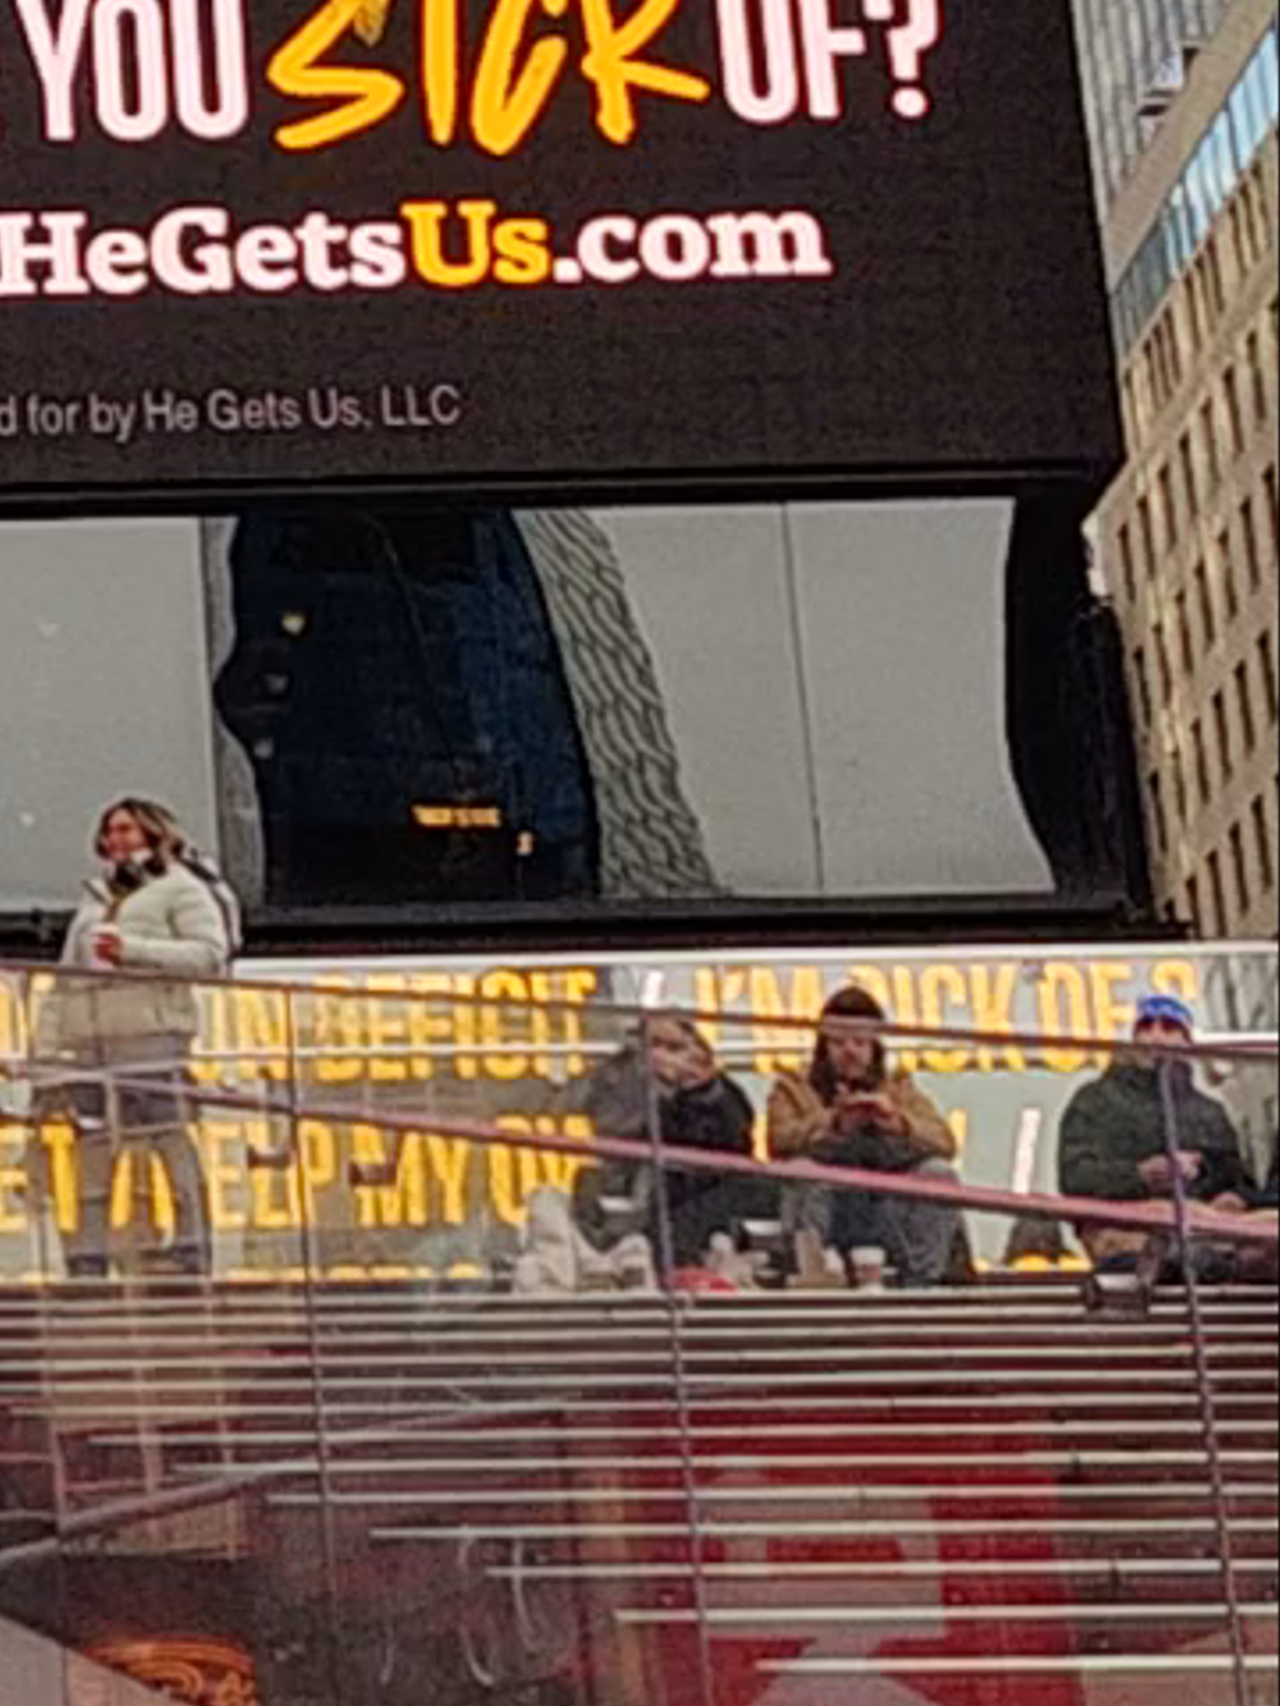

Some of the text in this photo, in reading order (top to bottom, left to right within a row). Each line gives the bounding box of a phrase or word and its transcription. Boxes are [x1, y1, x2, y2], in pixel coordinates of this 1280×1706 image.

[27, 396, 79, 434] for
[90, 394, 135, 442] by
[144, 392, 198, 431] He
[208, 389, 301, 430] Gets
[382, 384, 459, 426] LLC
